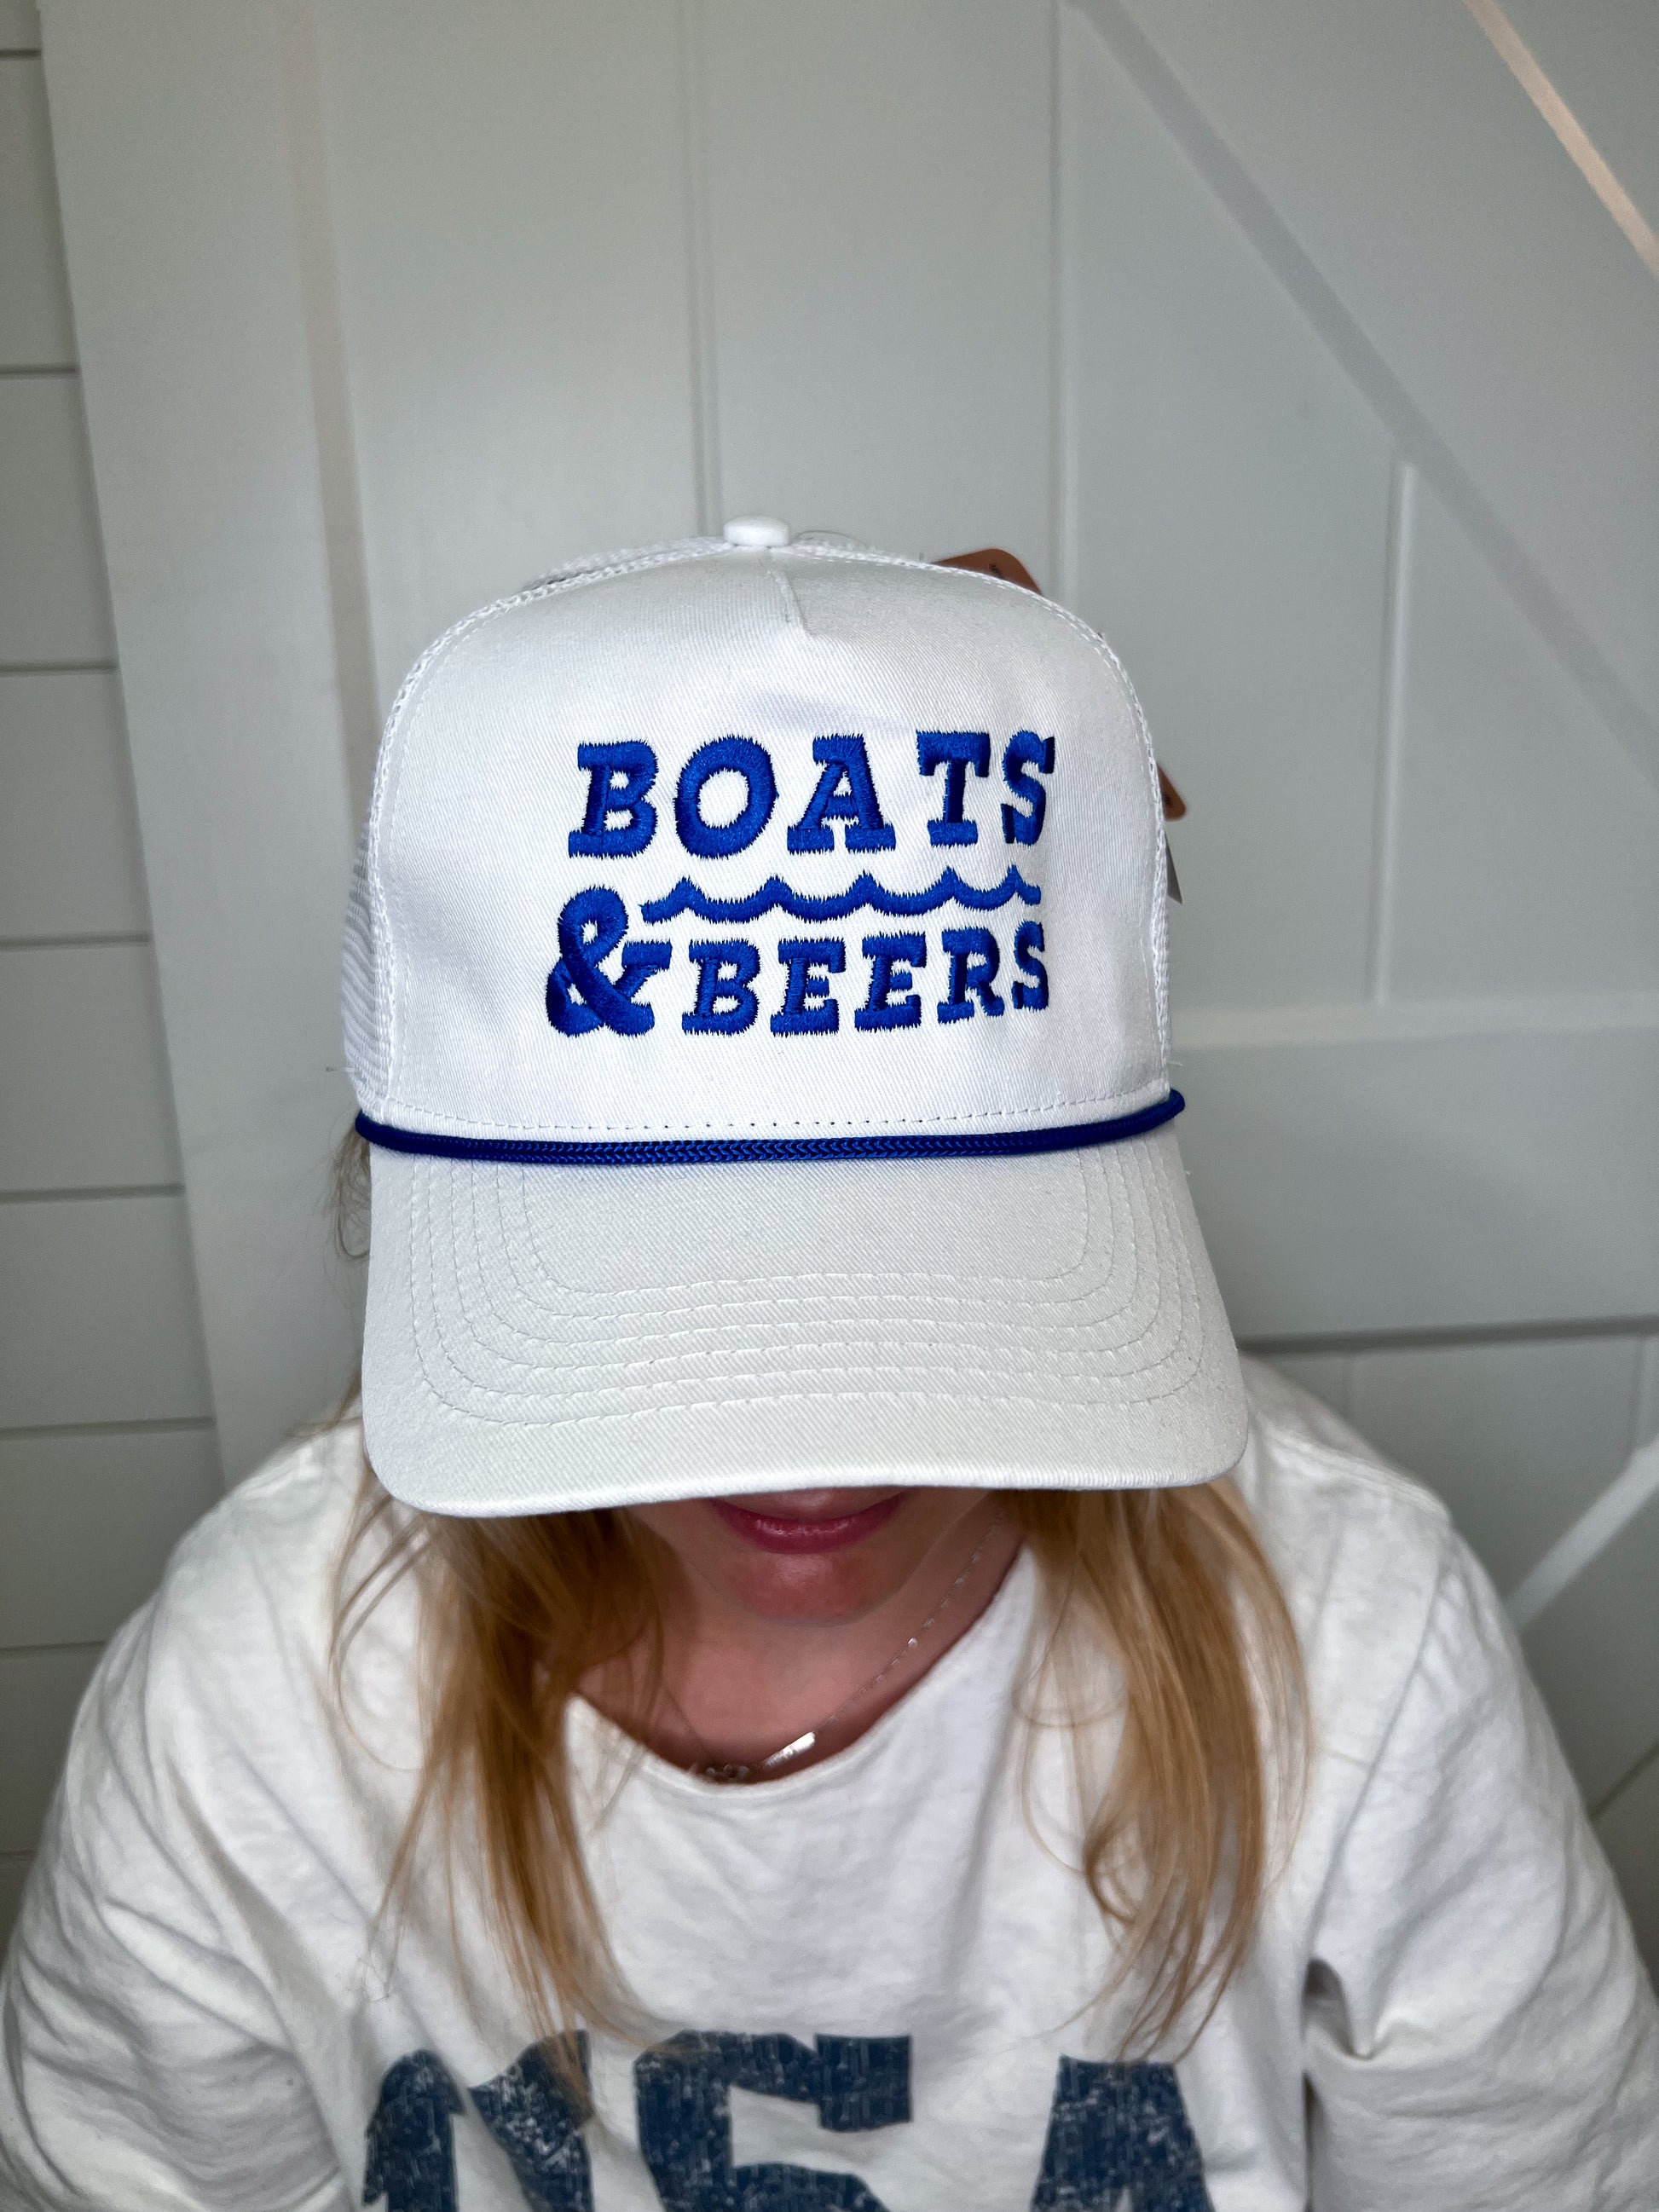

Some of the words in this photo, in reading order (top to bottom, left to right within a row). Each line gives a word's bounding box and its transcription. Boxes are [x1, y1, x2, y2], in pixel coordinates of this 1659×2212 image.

[568, 730, 1055, 859] BOATS
[546, 886, 673, 1037] &
[681, 921, 1049, 1037] BEERS
